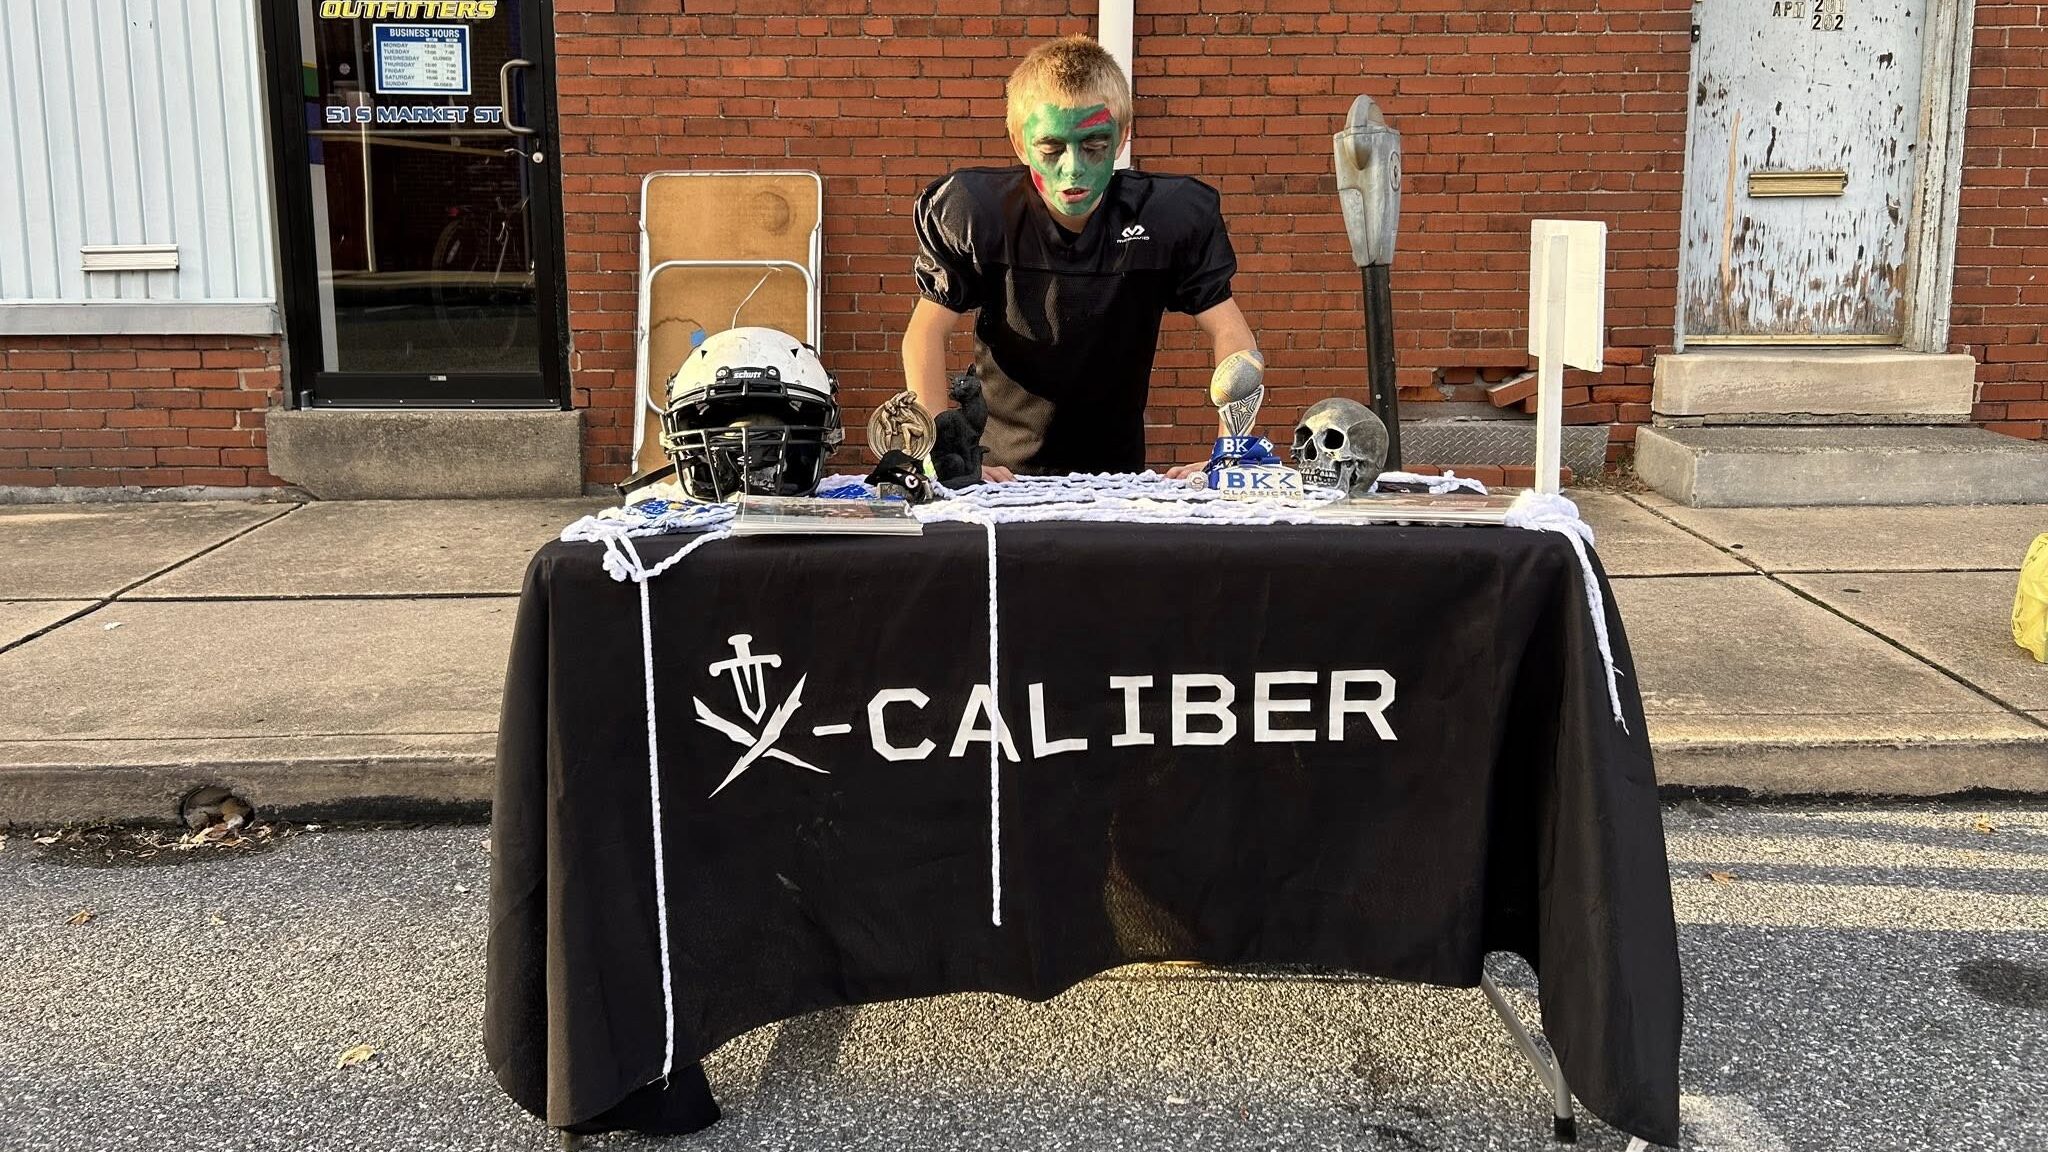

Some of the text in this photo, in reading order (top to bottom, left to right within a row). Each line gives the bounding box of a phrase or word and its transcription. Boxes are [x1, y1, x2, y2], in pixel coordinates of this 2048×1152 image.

[320, 0, 497, 19] OUTFITTERS
[1772, 1, 1805, 18] APT
[1812, 14, 1844, 31] 202
[389, 28, 460, 38] BUSINESS HOURS
[326, 106, 502, 123] 51 S MARKET ST
[1222, 438, 1249, 452] BK
